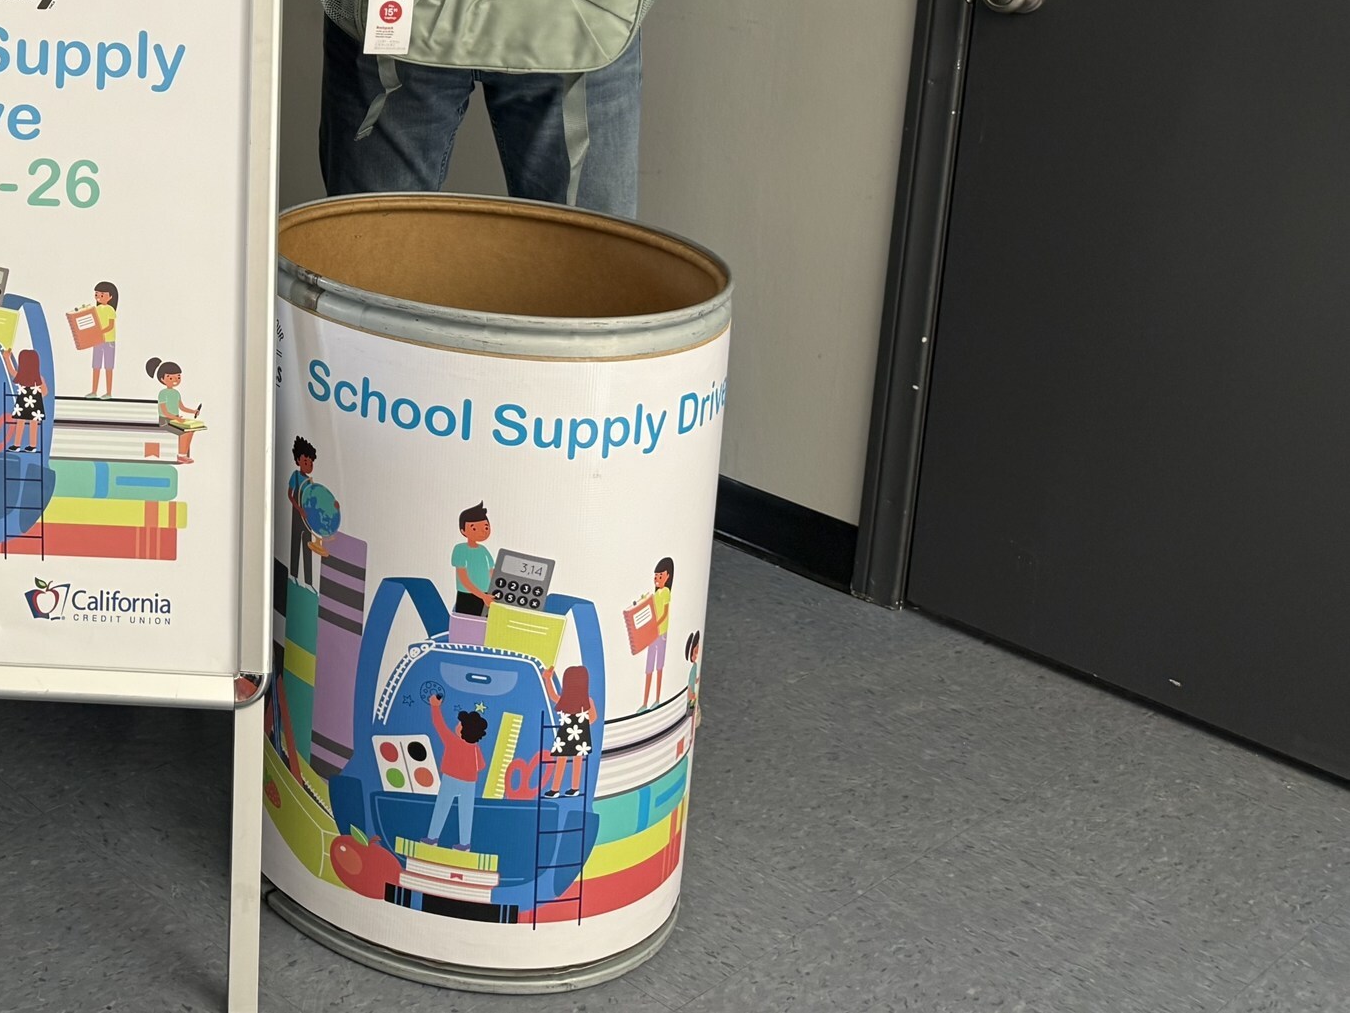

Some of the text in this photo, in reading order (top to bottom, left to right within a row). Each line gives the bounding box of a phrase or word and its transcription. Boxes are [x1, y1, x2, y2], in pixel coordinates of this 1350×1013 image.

[307, 360, 473, 441] School
[492, 404, 667, 460] Supply
[72, 590, 170, 613] California
[73, 614, 170, 625] CREDIT UNION
